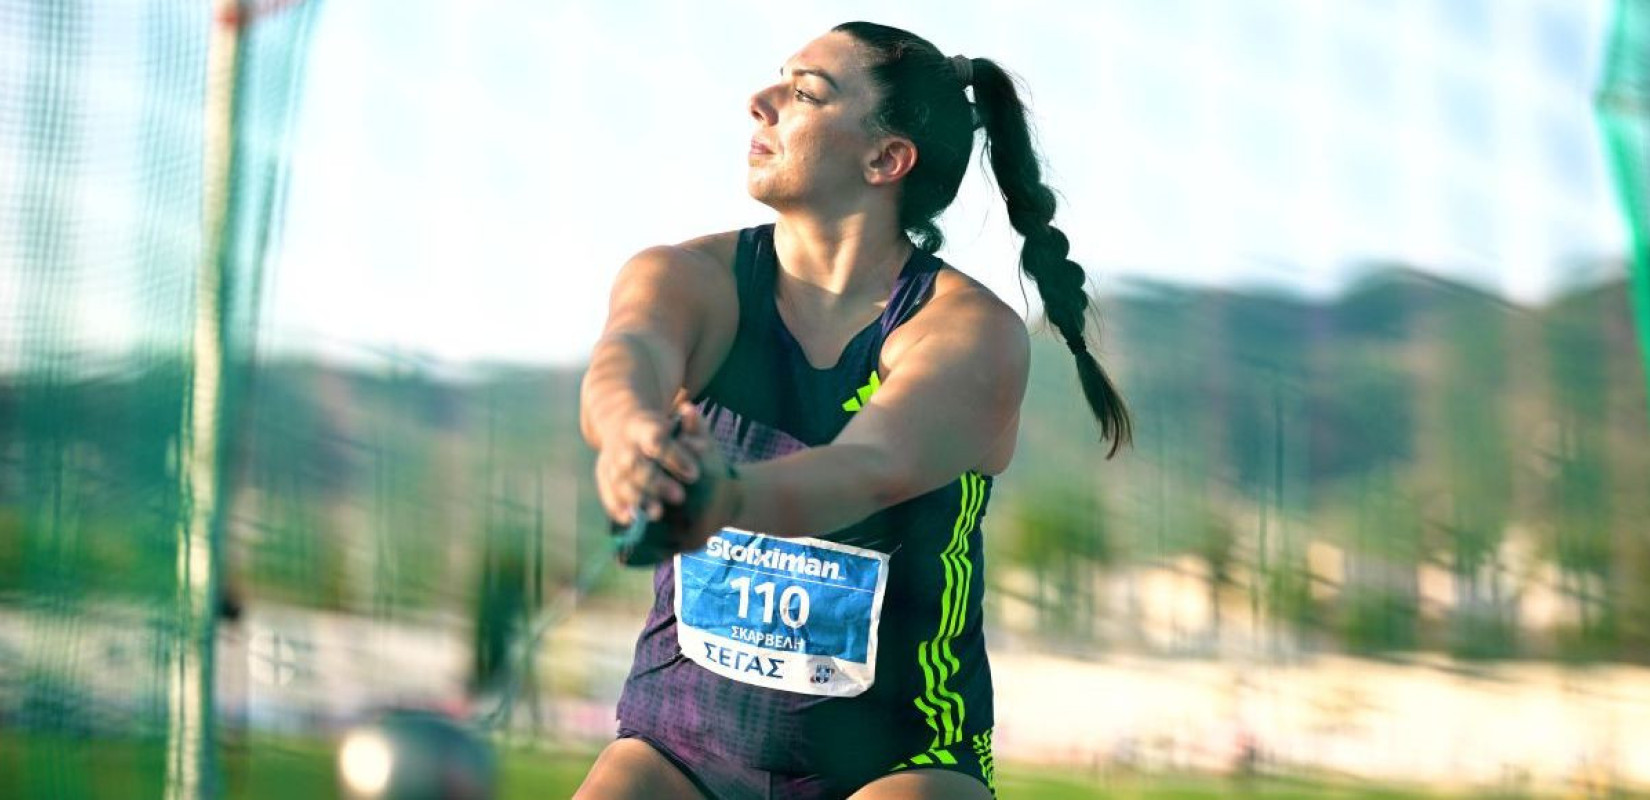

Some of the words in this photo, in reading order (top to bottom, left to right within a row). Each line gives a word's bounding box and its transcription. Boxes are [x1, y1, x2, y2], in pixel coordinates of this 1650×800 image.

[729, 576, 810, 630] 110
[731, 626, 805, 650] ΣΚΑΡΒΕΛΗ
[704, 642, 785, 679] ΣΕΓΑΣ
